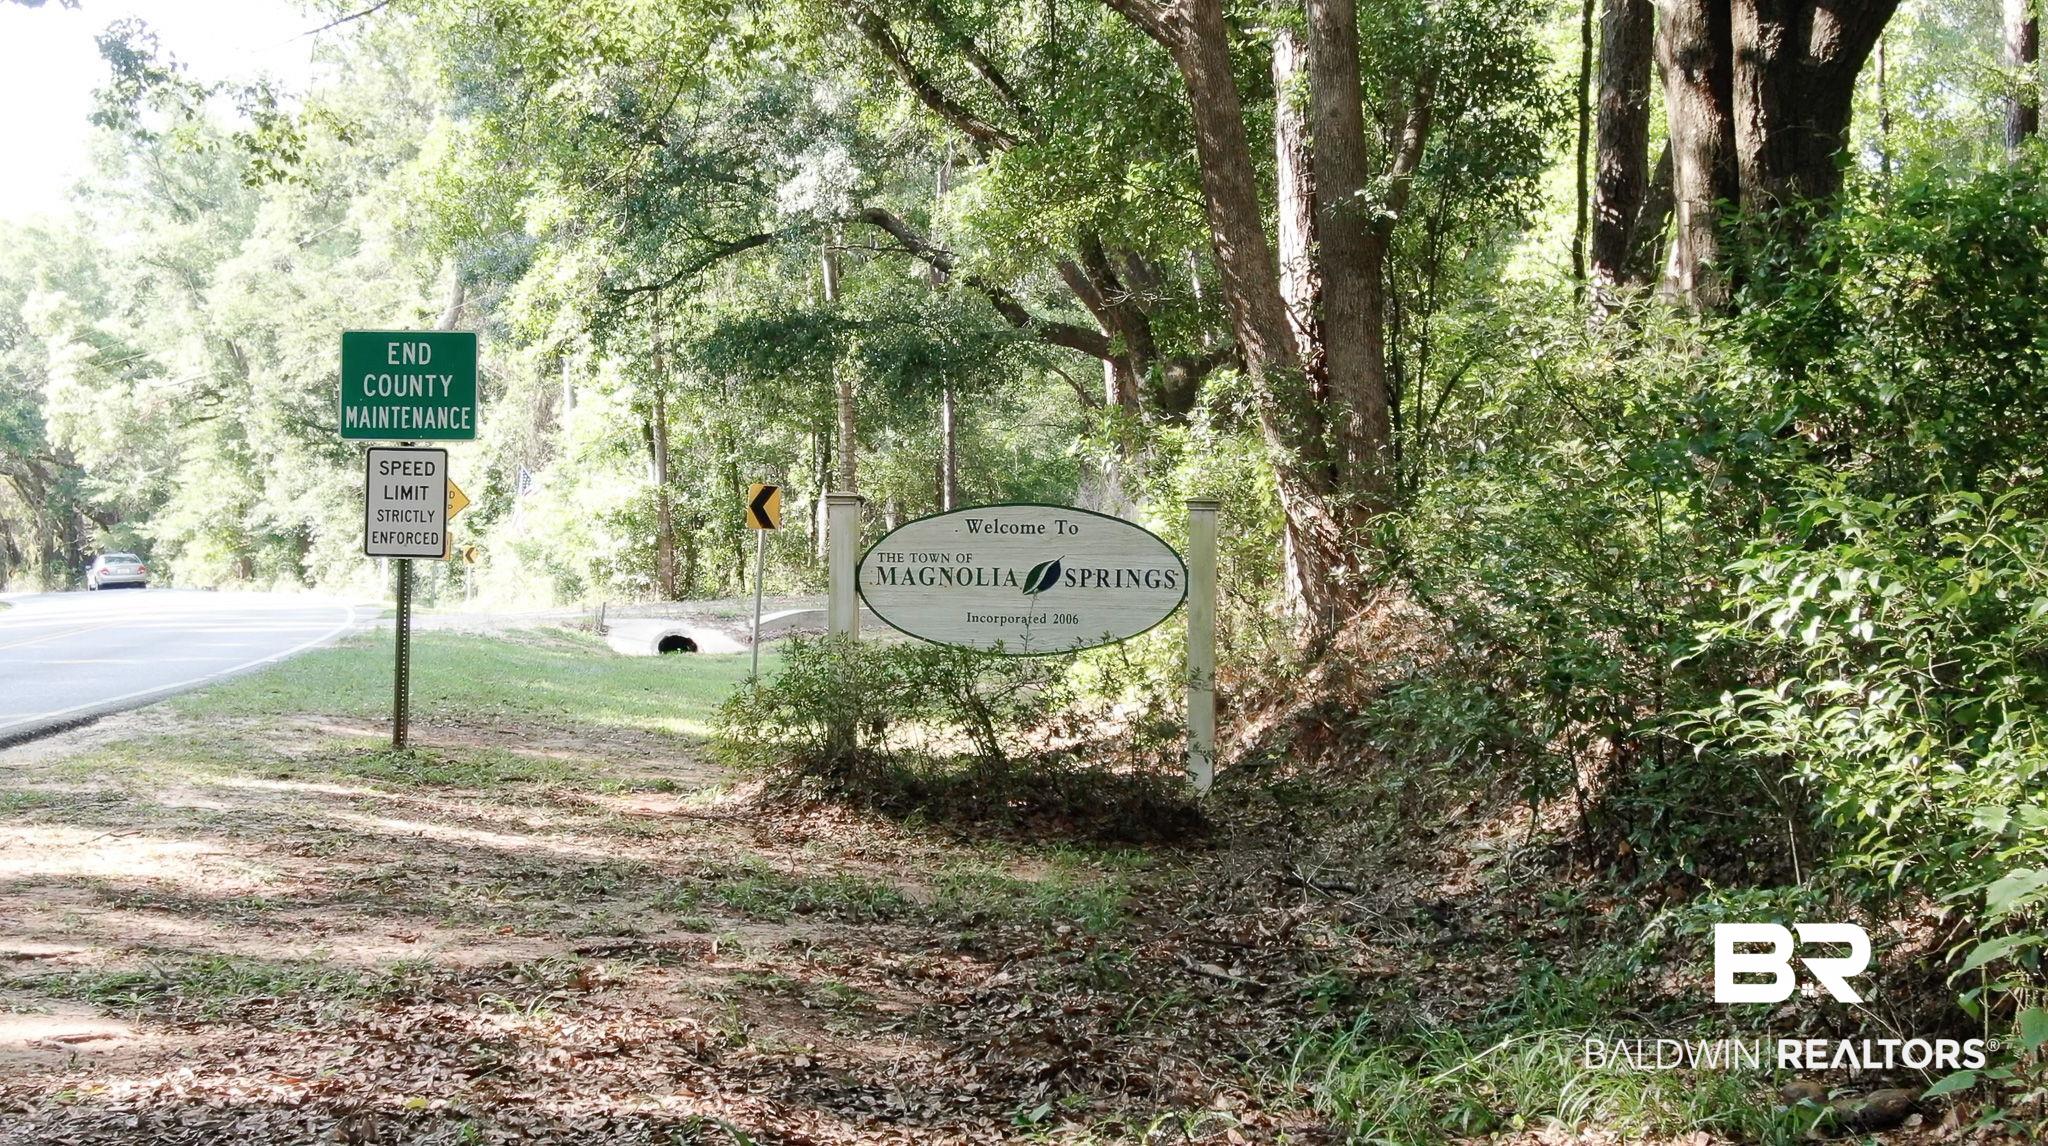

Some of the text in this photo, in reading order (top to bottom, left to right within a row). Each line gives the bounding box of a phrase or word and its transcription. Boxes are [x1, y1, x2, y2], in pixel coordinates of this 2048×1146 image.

[387, 342, 432, 365] END
[363, 373, 453, 397] COUNTY
[346, 406, 471, 429] MAINTENANCE
[379, 460, 436, 476] SPEED
[384, 485, 429, 500] LIMIT
[376, 509, 436, 523] STRICTLY
[965, 518, 1079, 535] Welcome To
[372, 531, 439, 545] ENFORCED
[877, 552, 973, 563] THE TOWN OF
[875, 566, 1177, 590] MAGNOLIA SPRINGS
[966, 611, 1079, 626] Incorporated 2006
